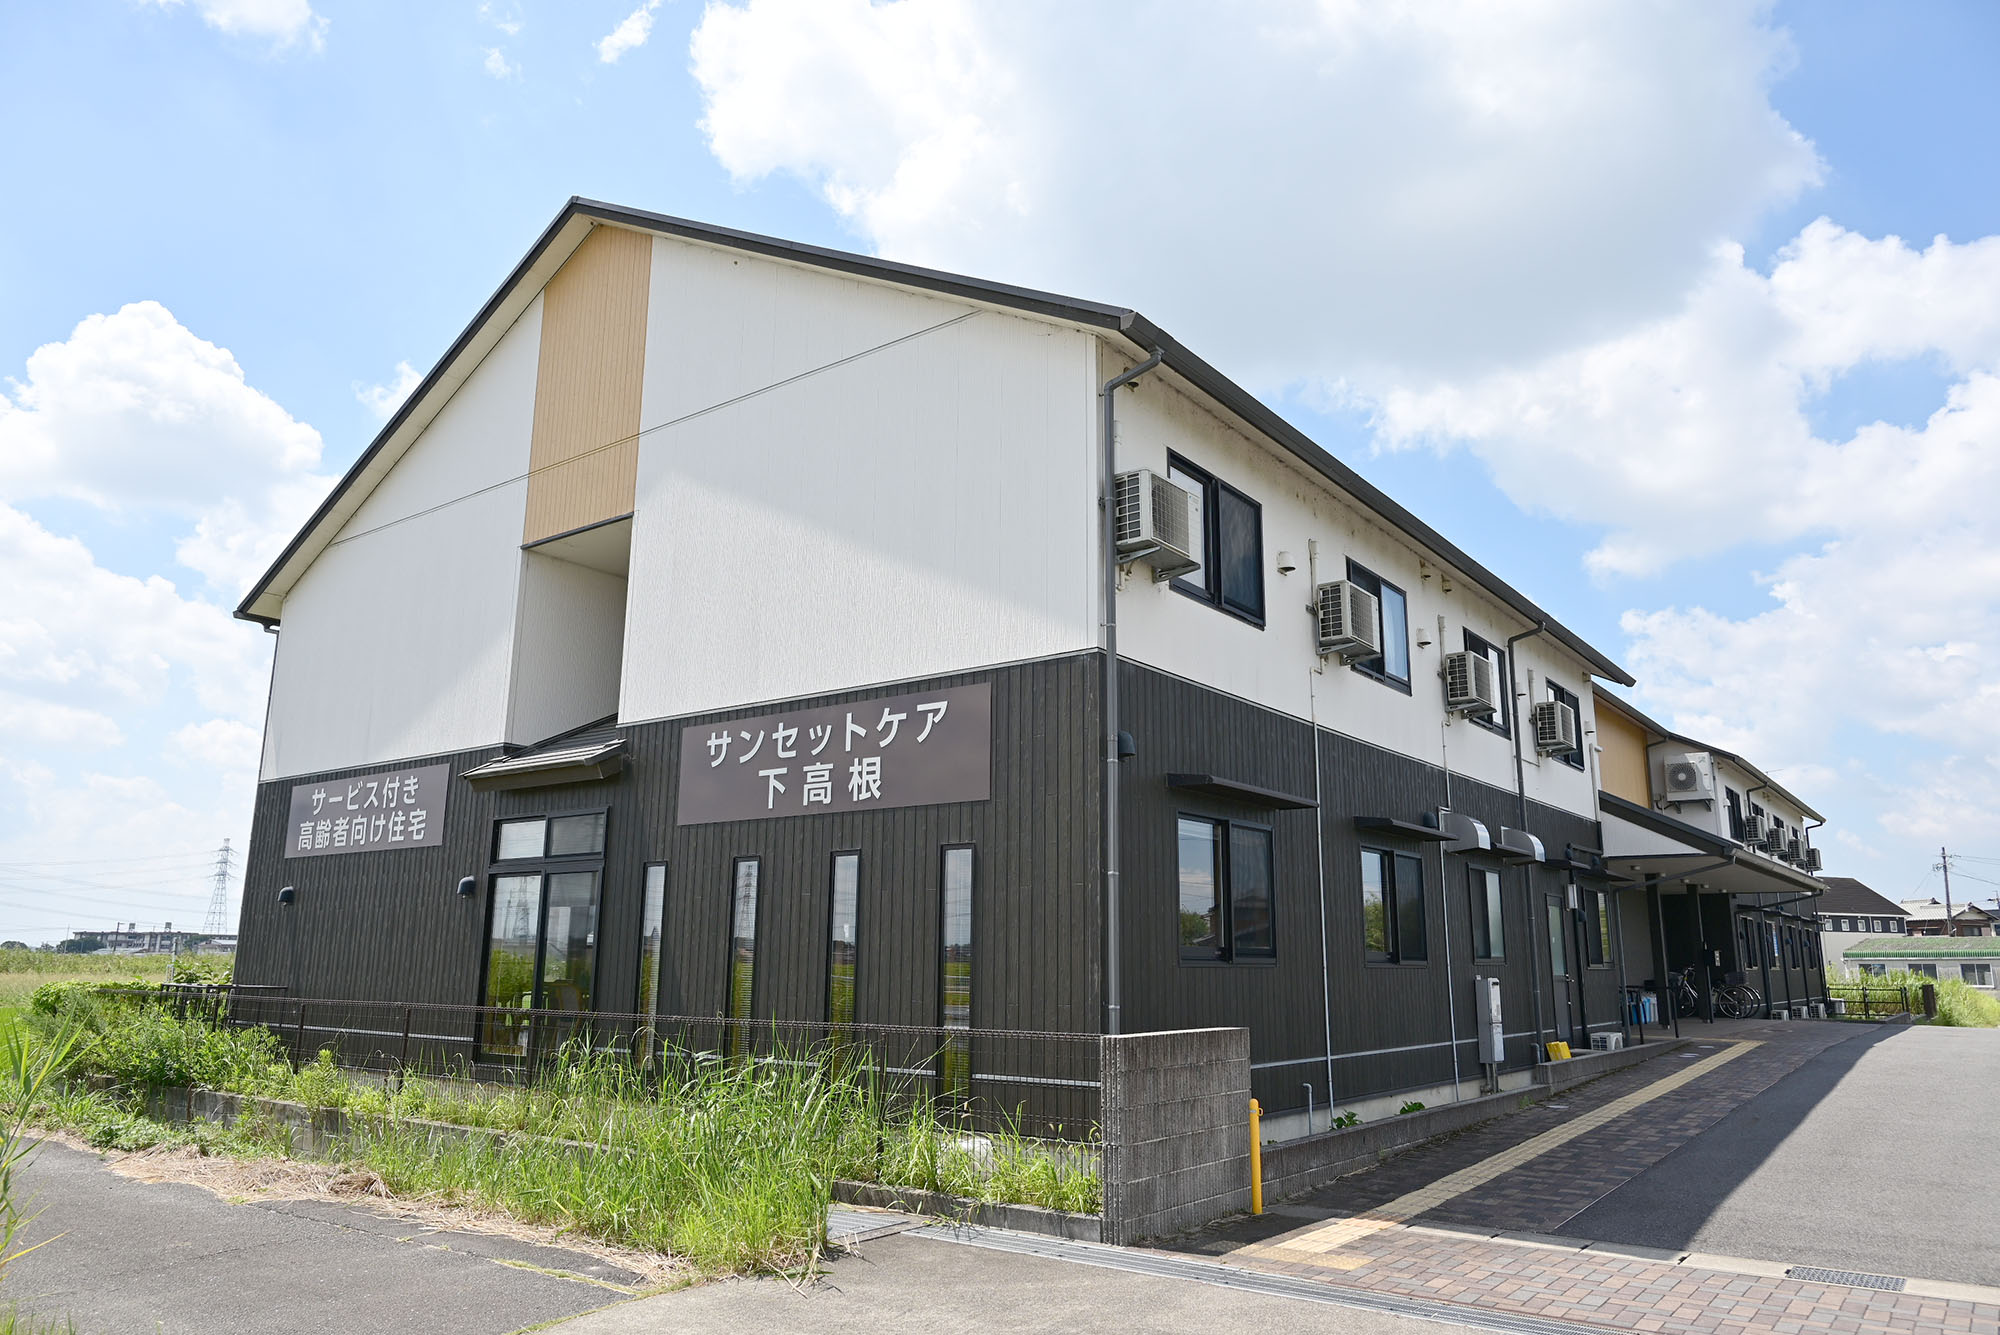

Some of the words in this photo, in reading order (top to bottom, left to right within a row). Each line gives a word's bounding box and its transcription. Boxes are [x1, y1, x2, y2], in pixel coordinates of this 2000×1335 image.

[706, 700, 948, 768] サンセットケア
[312, 775, 419, 816] サービス付き
[758, 756, 882, 809] 下高根
[298, 808, 427, 851] 高齢者向け住宅
